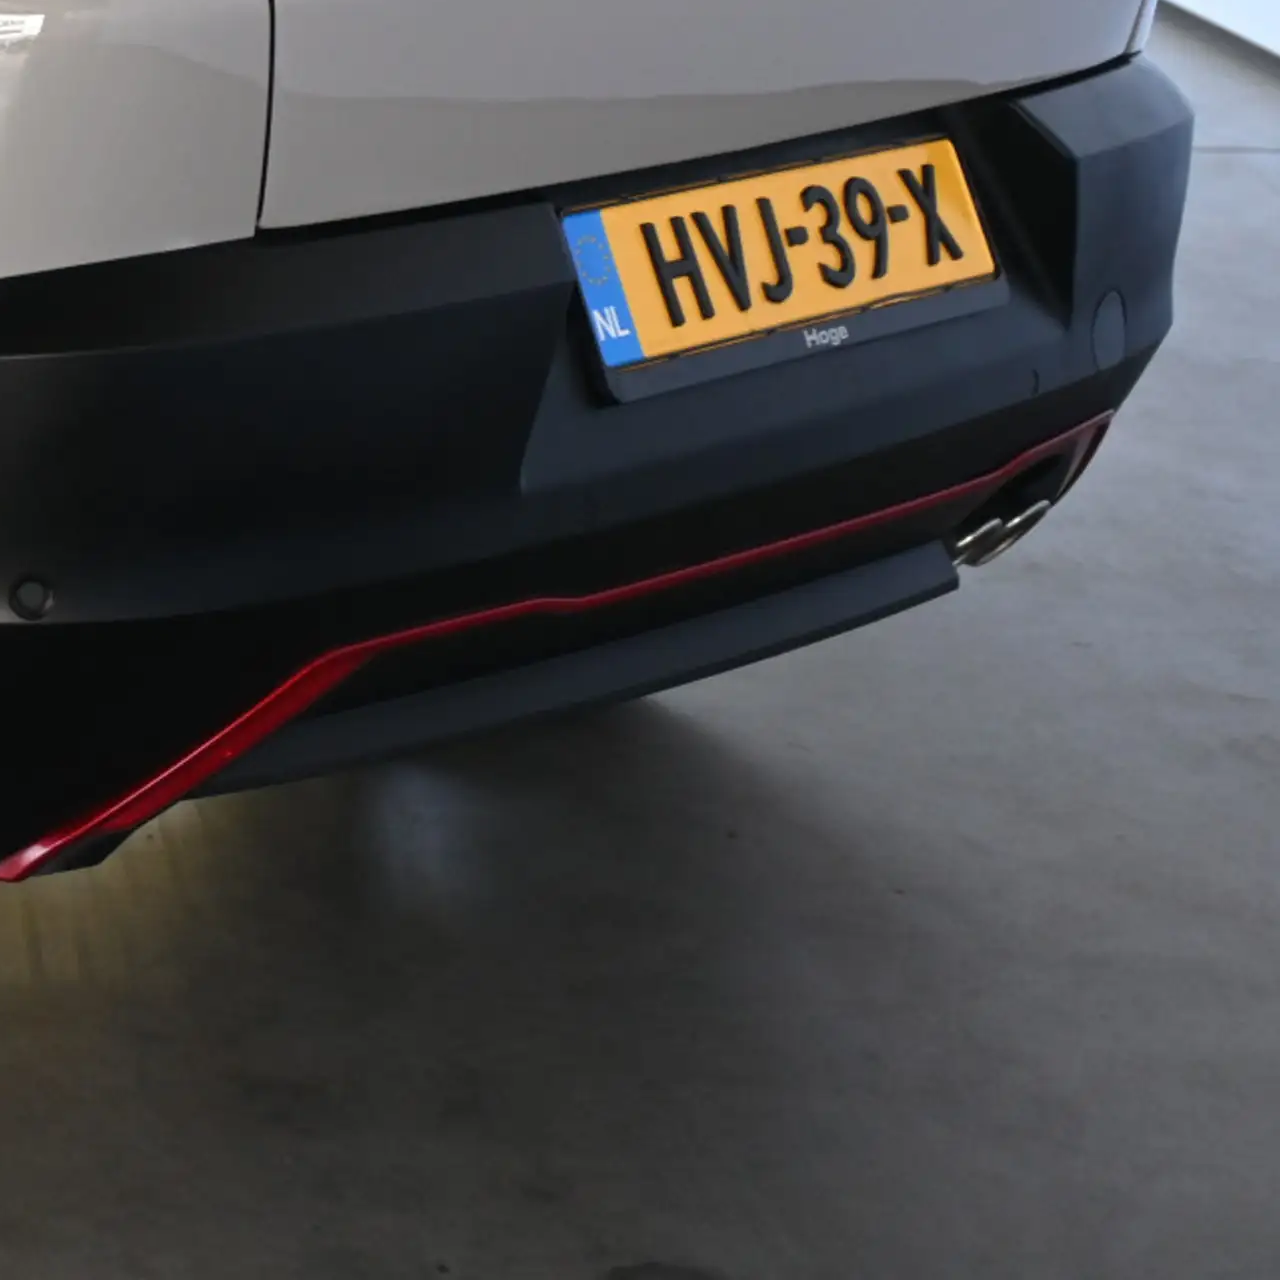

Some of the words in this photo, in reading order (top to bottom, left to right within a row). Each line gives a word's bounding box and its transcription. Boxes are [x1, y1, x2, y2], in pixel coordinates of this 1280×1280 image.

[638, 163, 965, 328] HVJ-39-X
[591, 303, 631, 344] NL
[802, 325, 849, 349] Hoge
